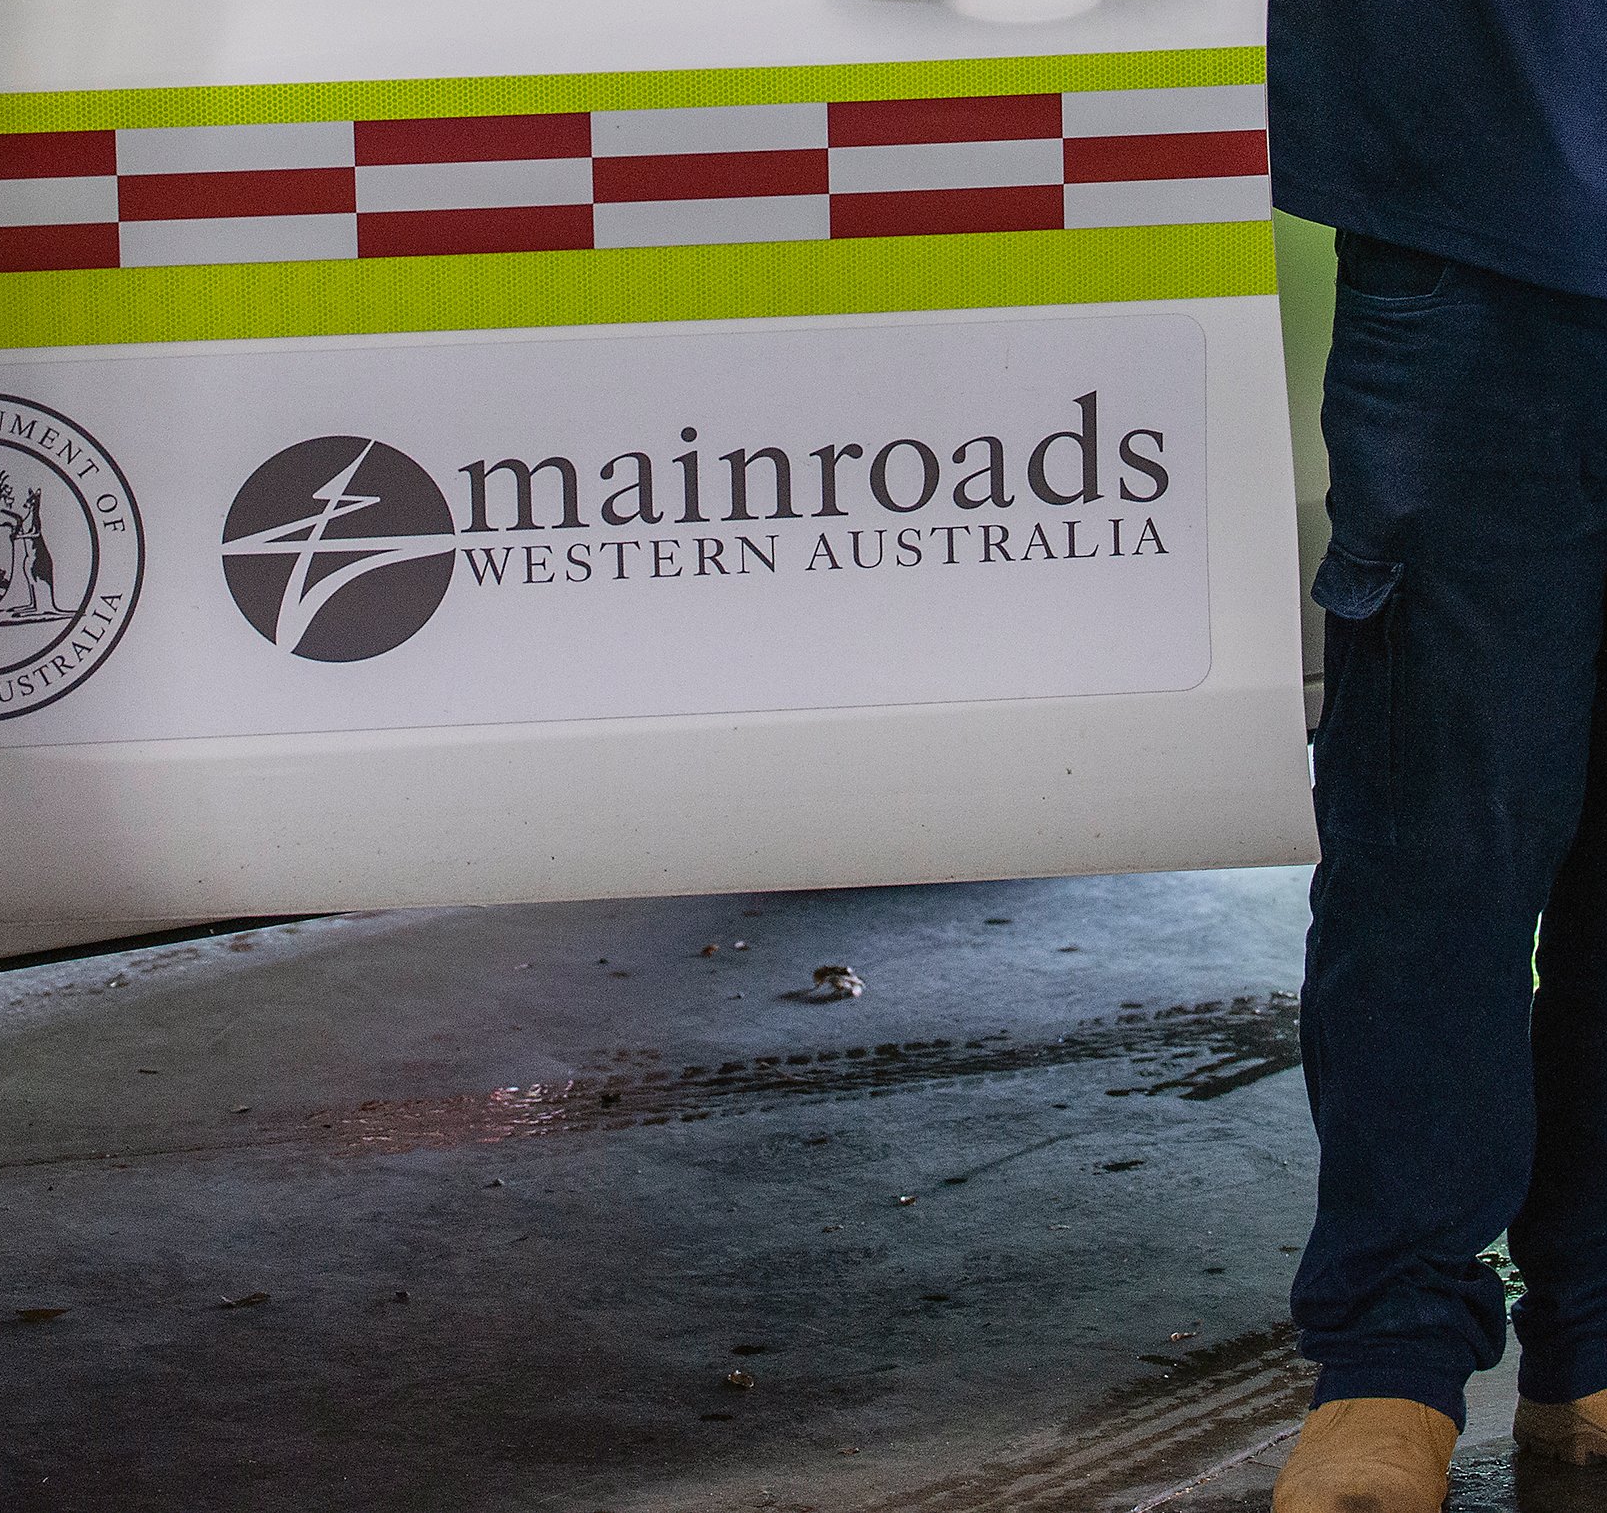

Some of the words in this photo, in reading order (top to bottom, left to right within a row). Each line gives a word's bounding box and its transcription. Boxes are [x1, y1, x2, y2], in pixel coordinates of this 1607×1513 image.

[458, 389, 1169, 533] mainroads
[95, 493, 126, 533] OF
[461, 534, 779, 587] WESTERN
[805, 517, 1169, 571] AUSTRALIA
